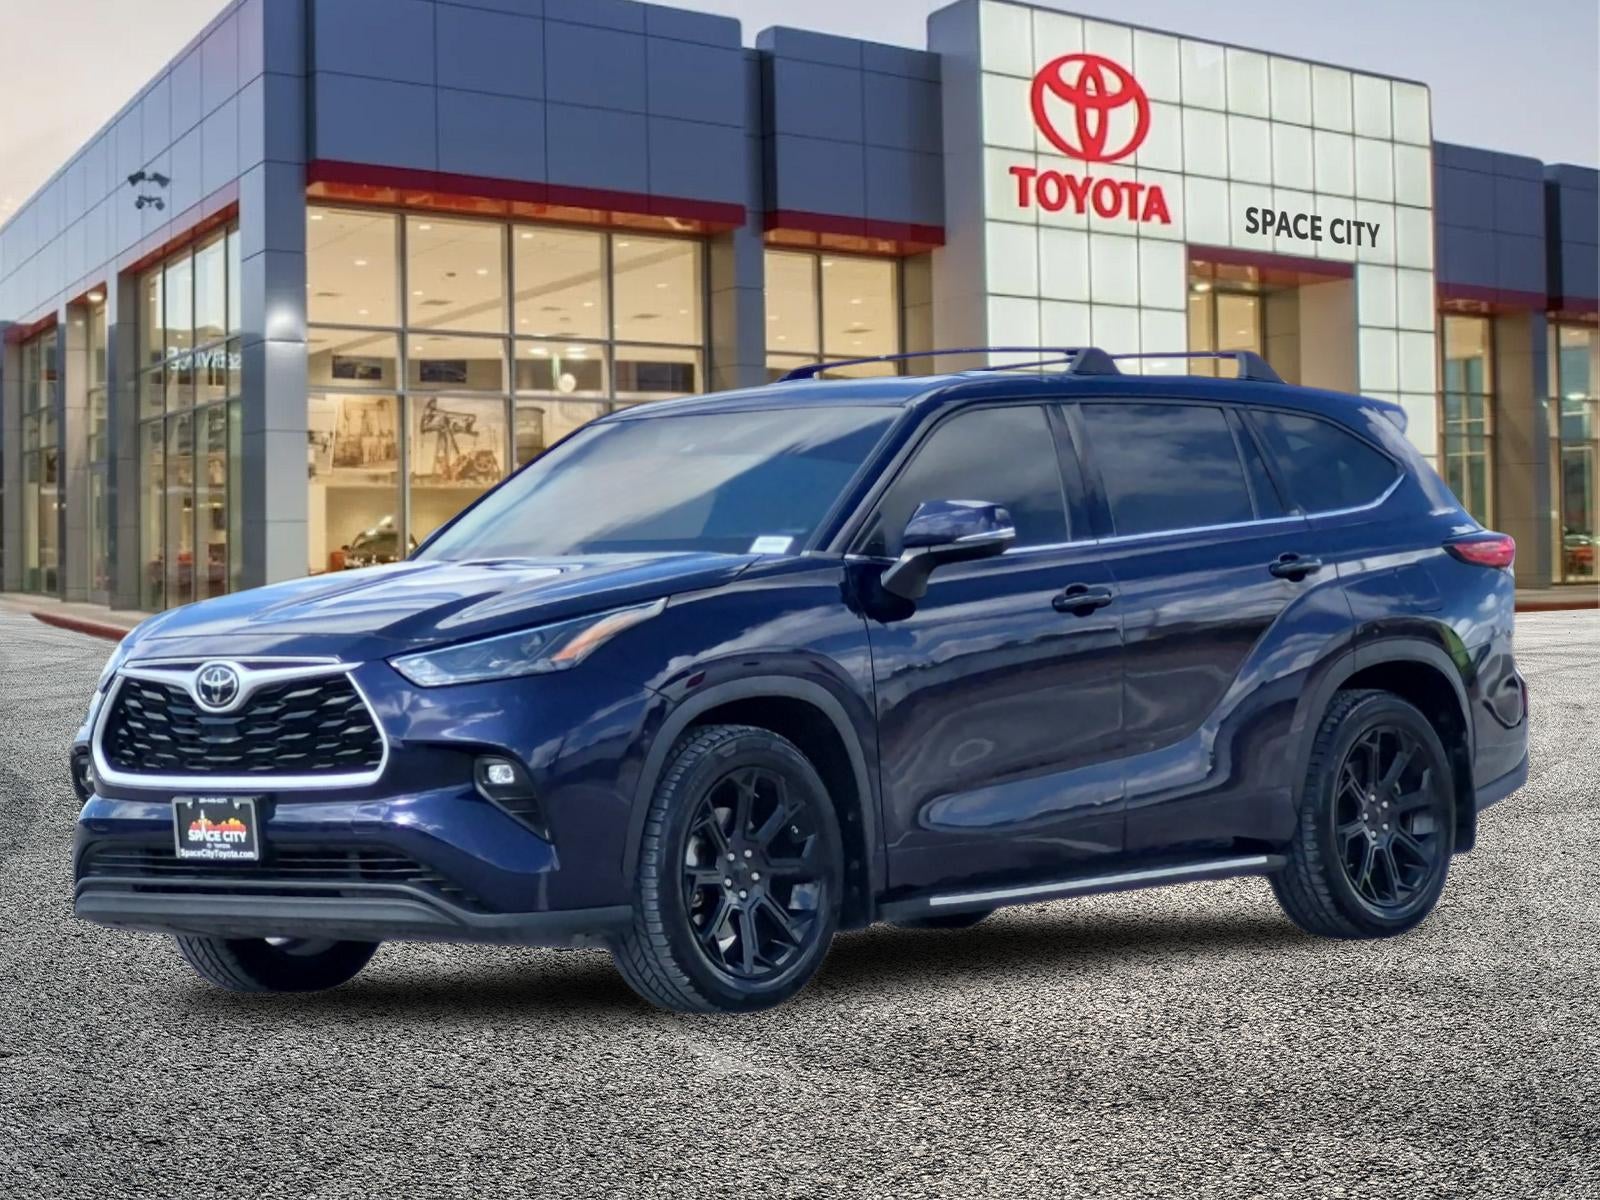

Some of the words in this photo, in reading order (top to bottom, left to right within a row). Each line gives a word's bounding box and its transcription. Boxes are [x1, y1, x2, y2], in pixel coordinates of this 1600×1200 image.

[1009, 166, 1171, 224] TOYOTA
[1245, 207, 1322, 241] SPACE
[1329, 218, 1381, 248] CITY
[188, 829, 221, 841] SPACE
[223, 831, 246, 842] CITY
[180, 848, 254, 859] SpaceCityToyota.com
